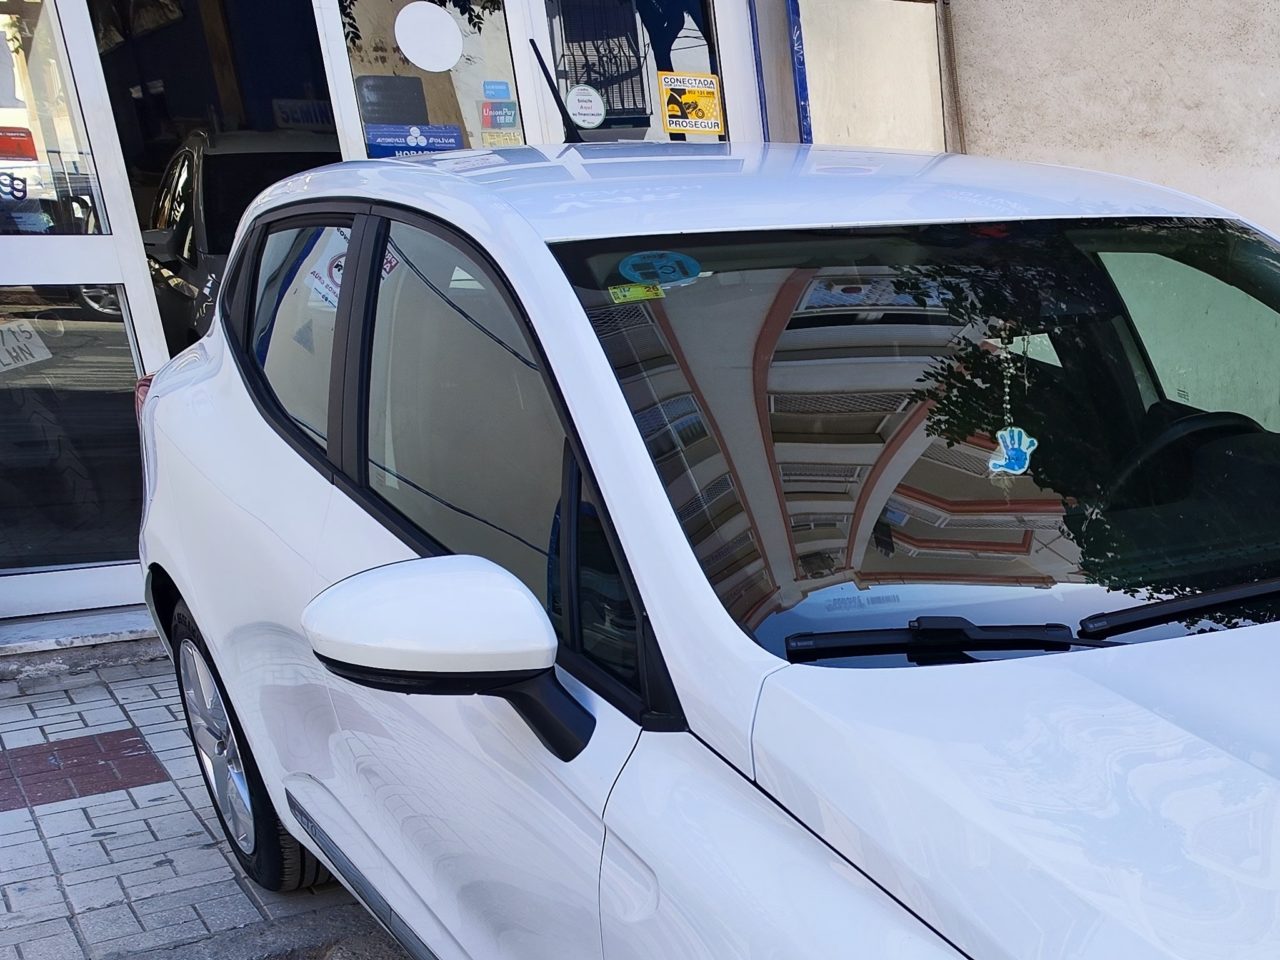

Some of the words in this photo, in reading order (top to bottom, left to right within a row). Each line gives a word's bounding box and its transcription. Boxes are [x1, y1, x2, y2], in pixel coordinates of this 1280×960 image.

[663, 76, 715, 87] CONECTADA
[483, 107, 515, 120] UnionPay
[668, 120, 720, 129] PROSEGUR
